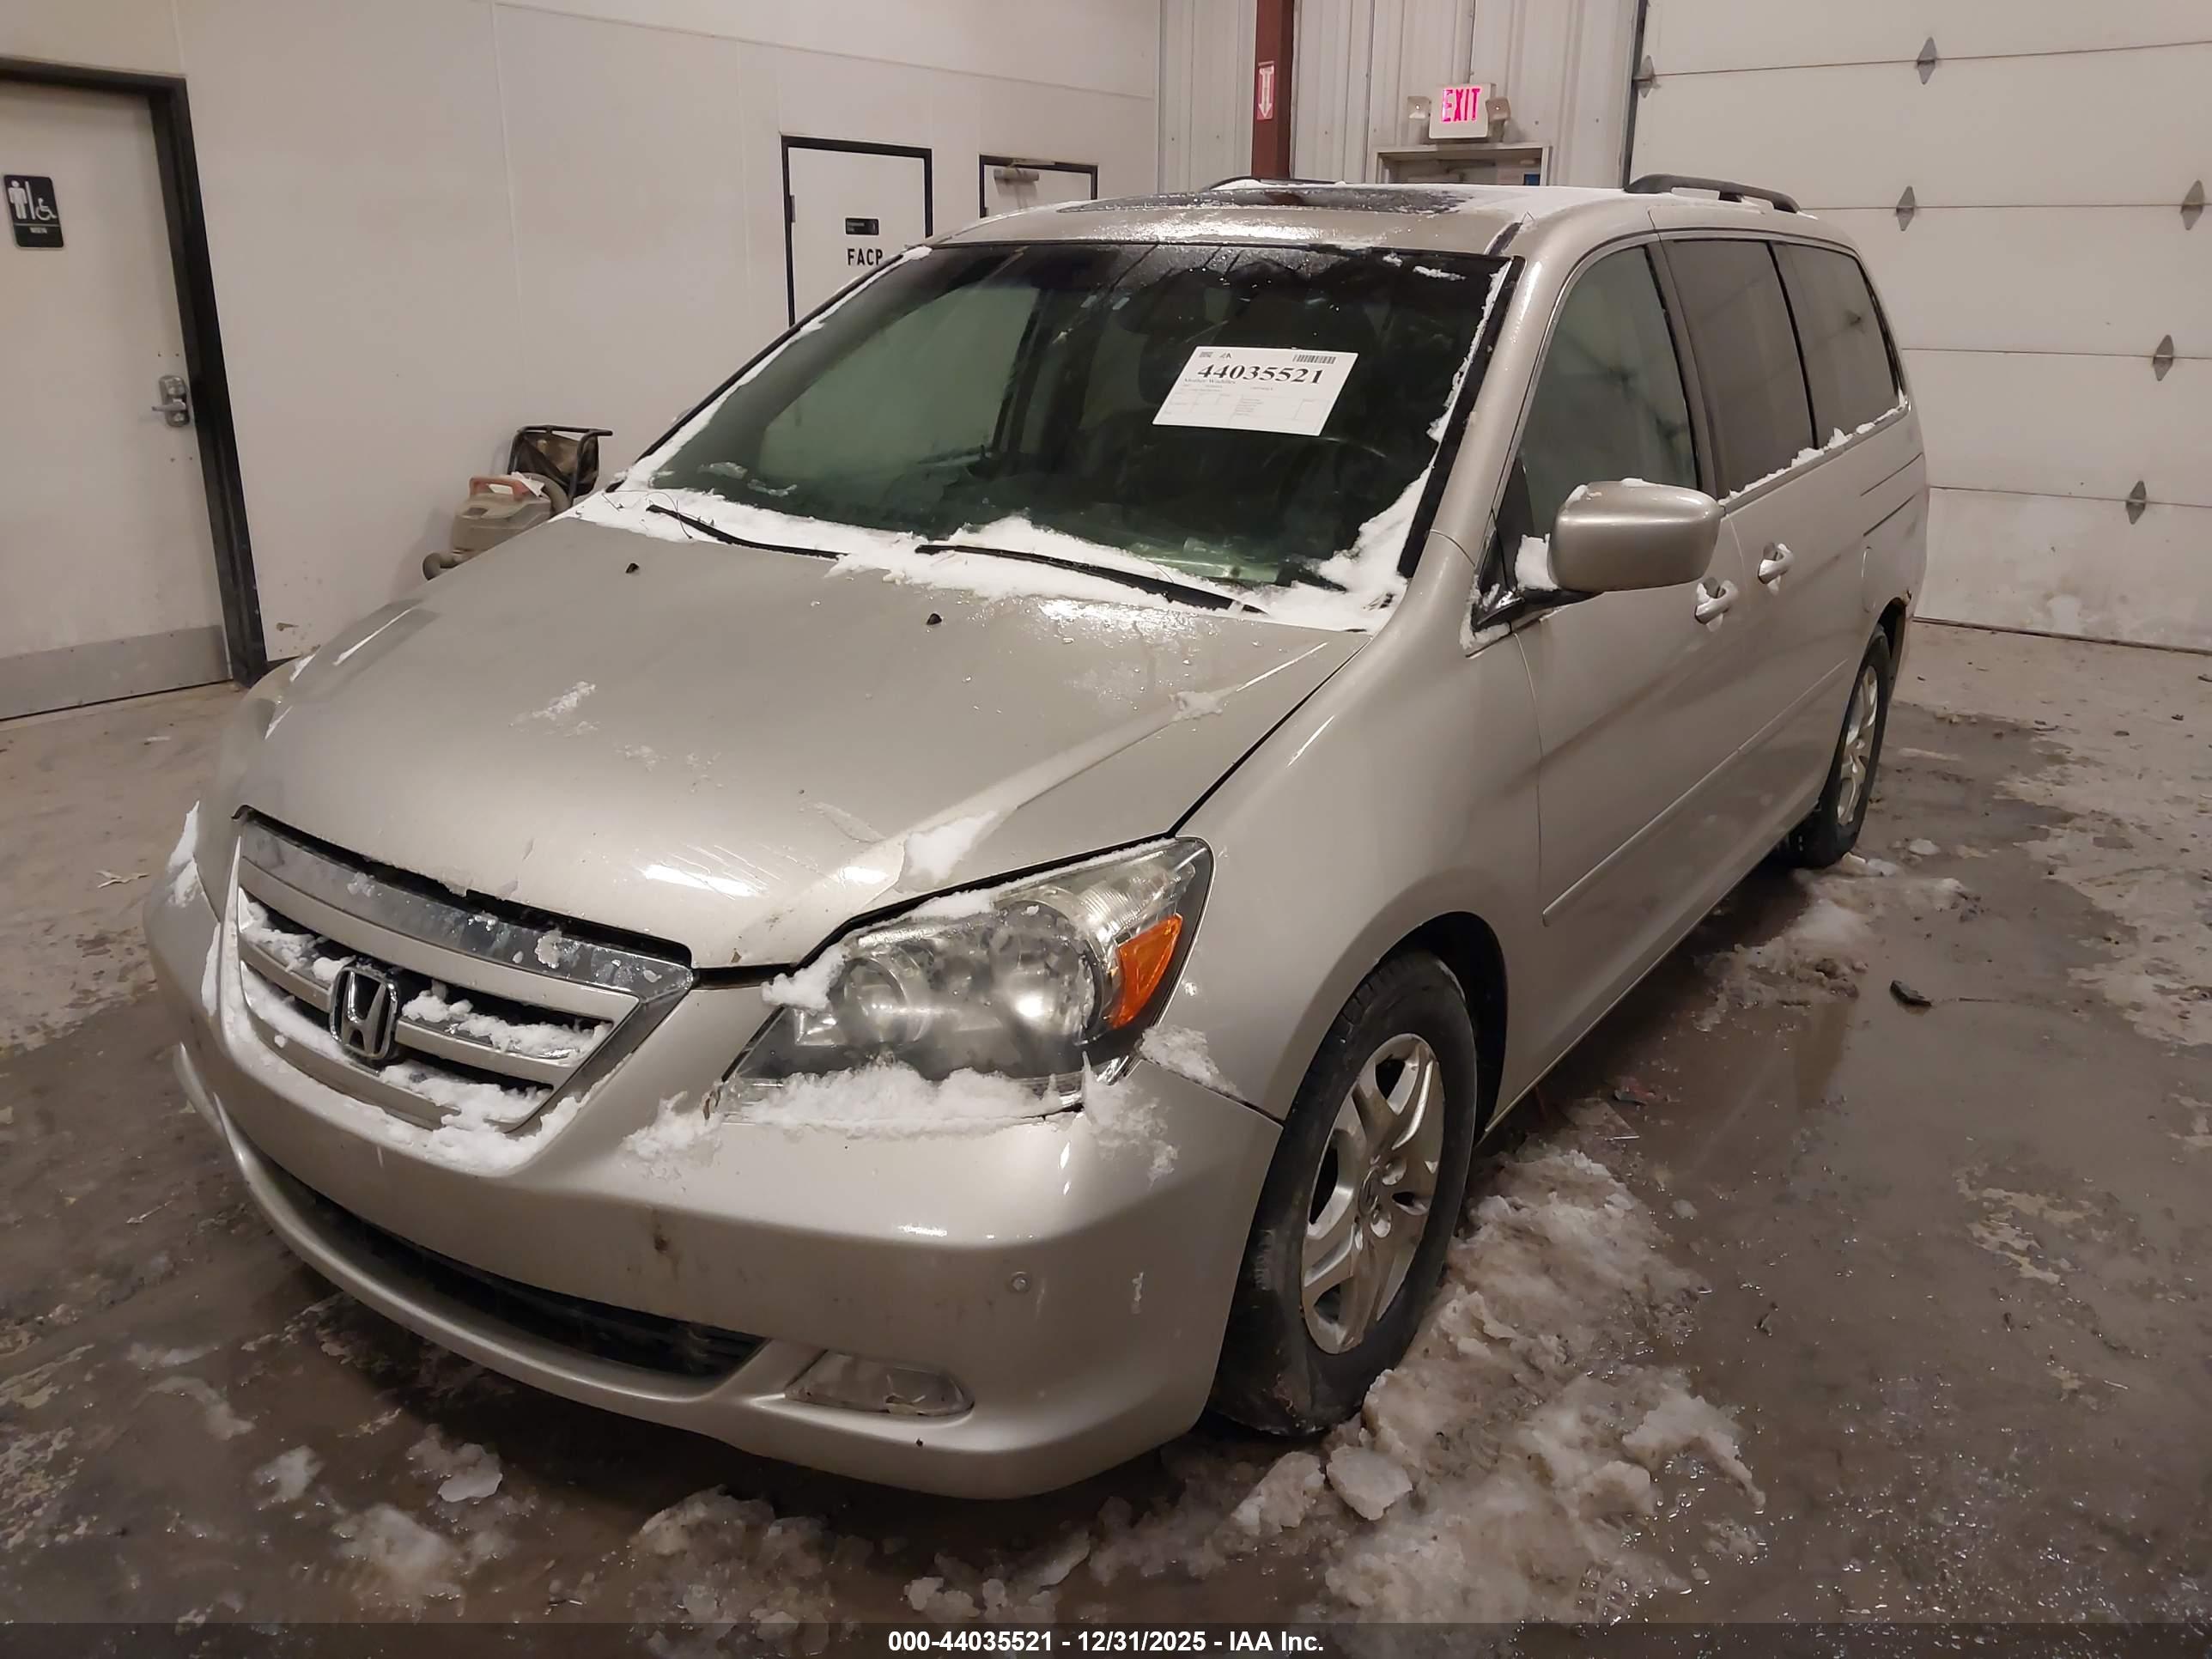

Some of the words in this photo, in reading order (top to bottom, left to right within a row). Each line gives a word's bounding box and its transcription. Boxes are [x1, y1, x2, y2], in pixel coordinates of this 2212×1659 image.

[1441, 88, 1480, 122] EXIT
[848, 248, 883, 265] FACP
[1198, 364, 1323, 384] 44035521
